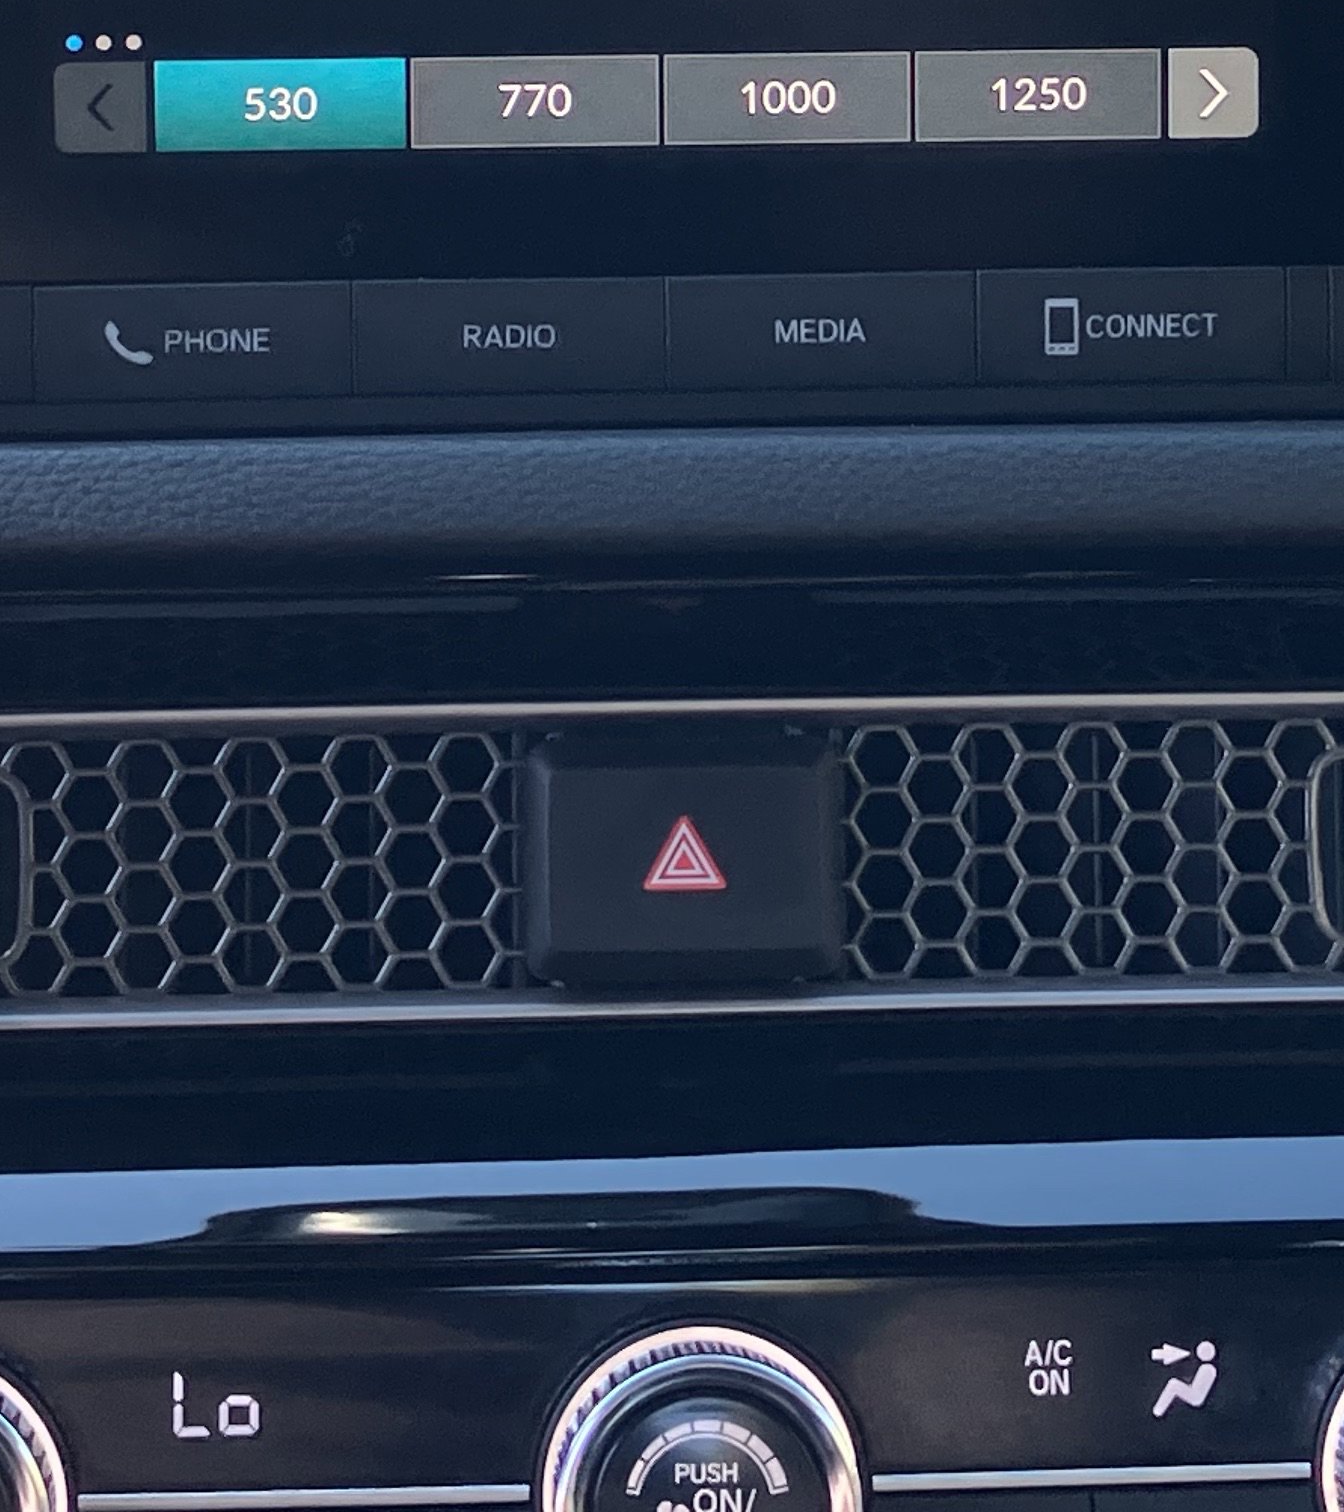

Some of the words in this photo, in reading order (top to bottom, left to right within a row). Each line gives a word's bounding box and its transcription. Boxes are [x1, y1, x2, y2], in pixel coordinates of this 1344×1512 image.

[243, 87, 319, 122] 530
[499, 84, 571, 116] 770
[742, 81, 835, 113] 1000
[992, 77, 1086, 110] 1250
[464, 325, 555, 348] RADIO
[775, 318, 865, 342] MEDIA
[1086, 313, 1217, 338] CONNECT
[165, 328, 269, 352] PHONE
[1025, 1340, 1072, 1366] A/C
[1029, 1369, 1069, 1395] ON
[173, 1372, 259, 1437] Lo
[675, 1462, 738, 1484] PUSH
